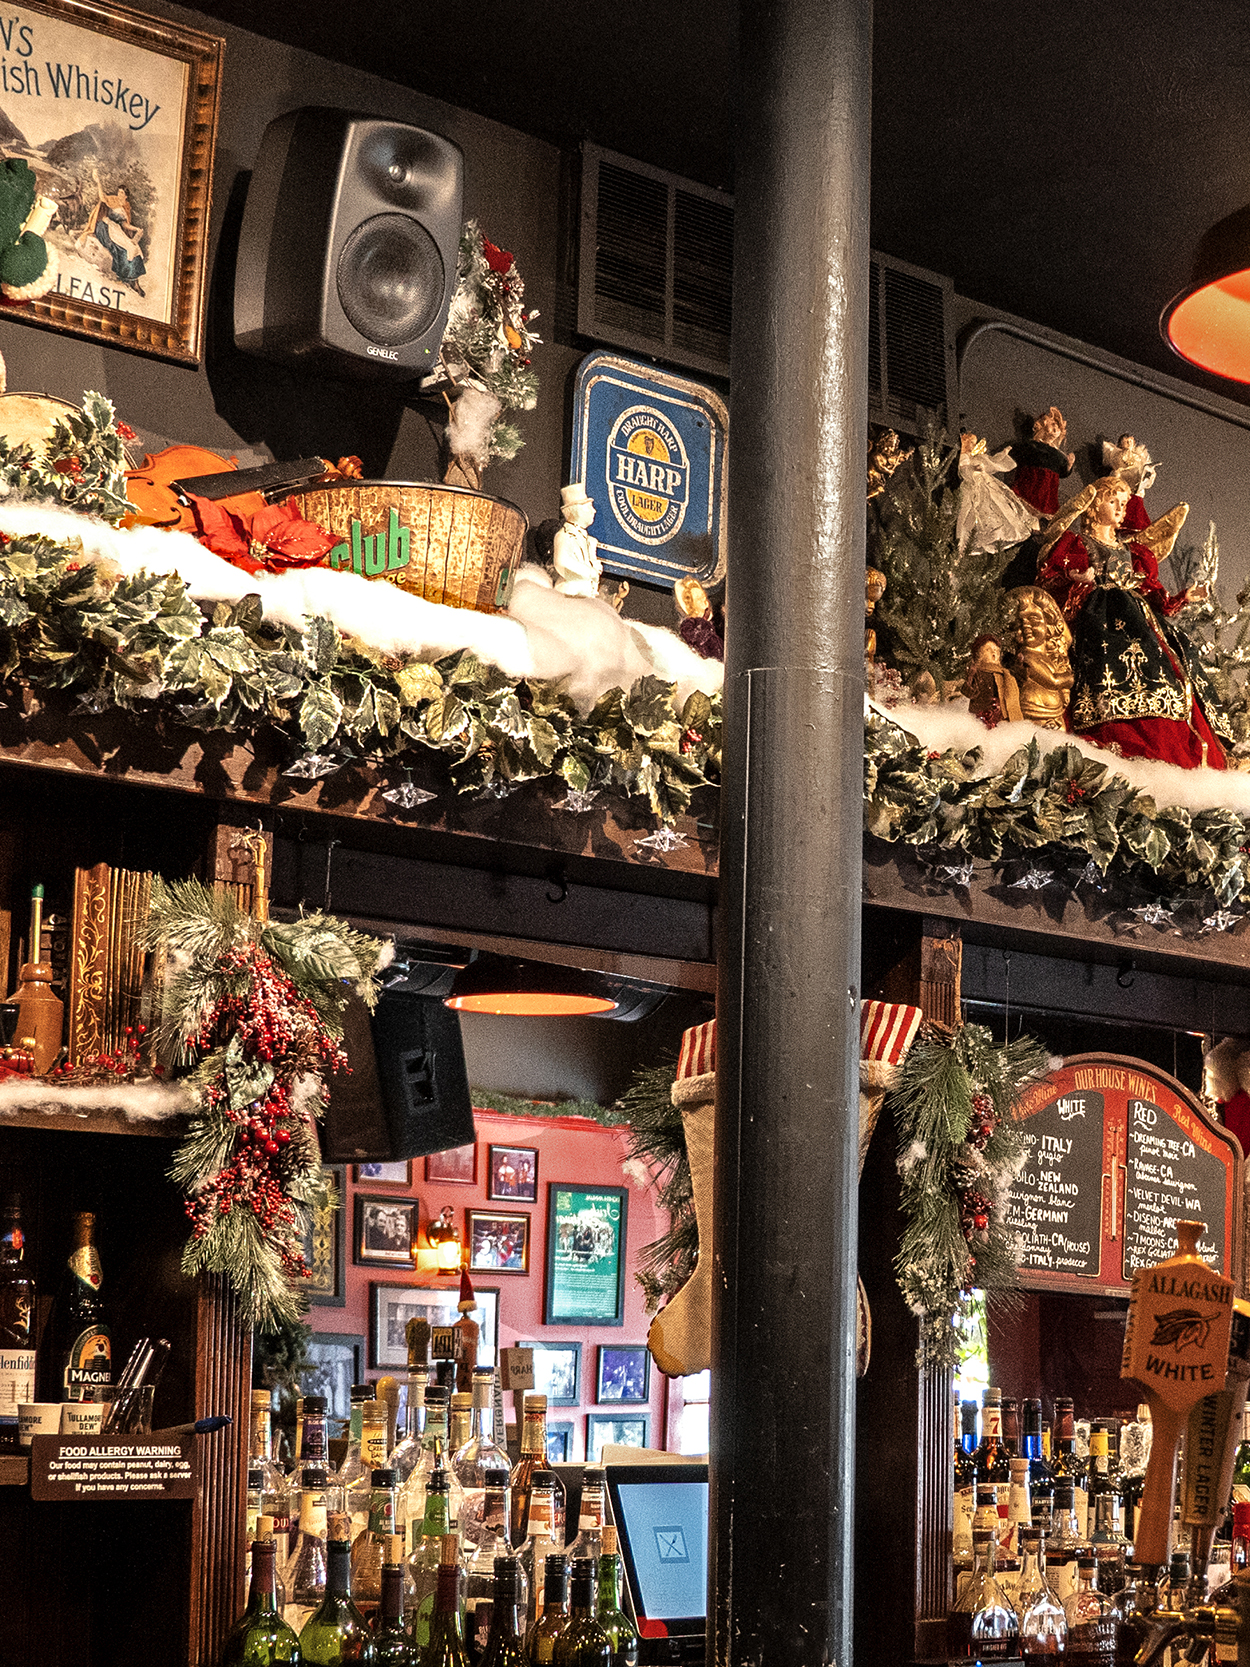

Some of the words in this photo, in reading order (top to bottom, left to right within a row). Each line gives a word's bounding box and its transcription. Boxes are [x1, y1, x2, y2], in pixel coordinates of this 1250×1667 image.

[1, 56, 41, 96] ish
[46, 61, 161, 131] Whiskey
[54, 273, 130, 313] LFAST.
[366, 345, 399, 361] GENELEC
[620, 414, 659, 437] DRAUGHT
[656, 422, 679, 453] HARP
[616, 453, 682, 496] HARP
[631, 494, 663, 514] LAGER
[625, 512, 662, 537] DRAUGHT
[658, 504, 679, 534] LAGER
[330, 506, 410, 577] club
[1074, 1068, 1096, 1091] OUR
[1096, 1067, 1126, 1090] HOUSE
[1128, 1073, 1158, 1103] WINES
[1056, 1098, 1086, 1115] WHITE
[1133, 1101, 1157, 1125] RED
[1172, 1104, 1190, 1130] Red
[1190, 1122, 1213, 1153] Wine
[1041, 1135, 1073, 1155] ITALY
[1040, 1170, 1061, 1183] NEW
[1007, 1188, 1047, 1206] auvignon
[1038, 1181, 1079, 1196] ZEALAND
[1148, 1273, 1231, 1304] ALLAGASH
[71, 1369, 111, 1383] MAGNE
[1145, 1353, 1215, 1381] WHITE
[989, 1417, 1000, 1435] 7
[59, 1447, 88, 1456] FOOD
[89, 1446, 135, 1456] ALLERGY
[135, 1446, 182, 1455] WARNING
[49, 1461, 63, 1470] Our
[64, 1461, 81, 1470] food
[82, 1462, 99, 1471] may
[99, 1460, 126, 1469] contain
[126, 1461, 154, 1470] peanut,
[57, 1472, 89, 1481] shellfish
[89, 1472, 124, 1481] products.
[124, 1472, 149, 1480] Please
[149, 1471, 162, 1479] ask
[82, 1484, 96, 1493] you
[96, 1483, 115, 1491] have
[115, 1484, 129, 1492] any
